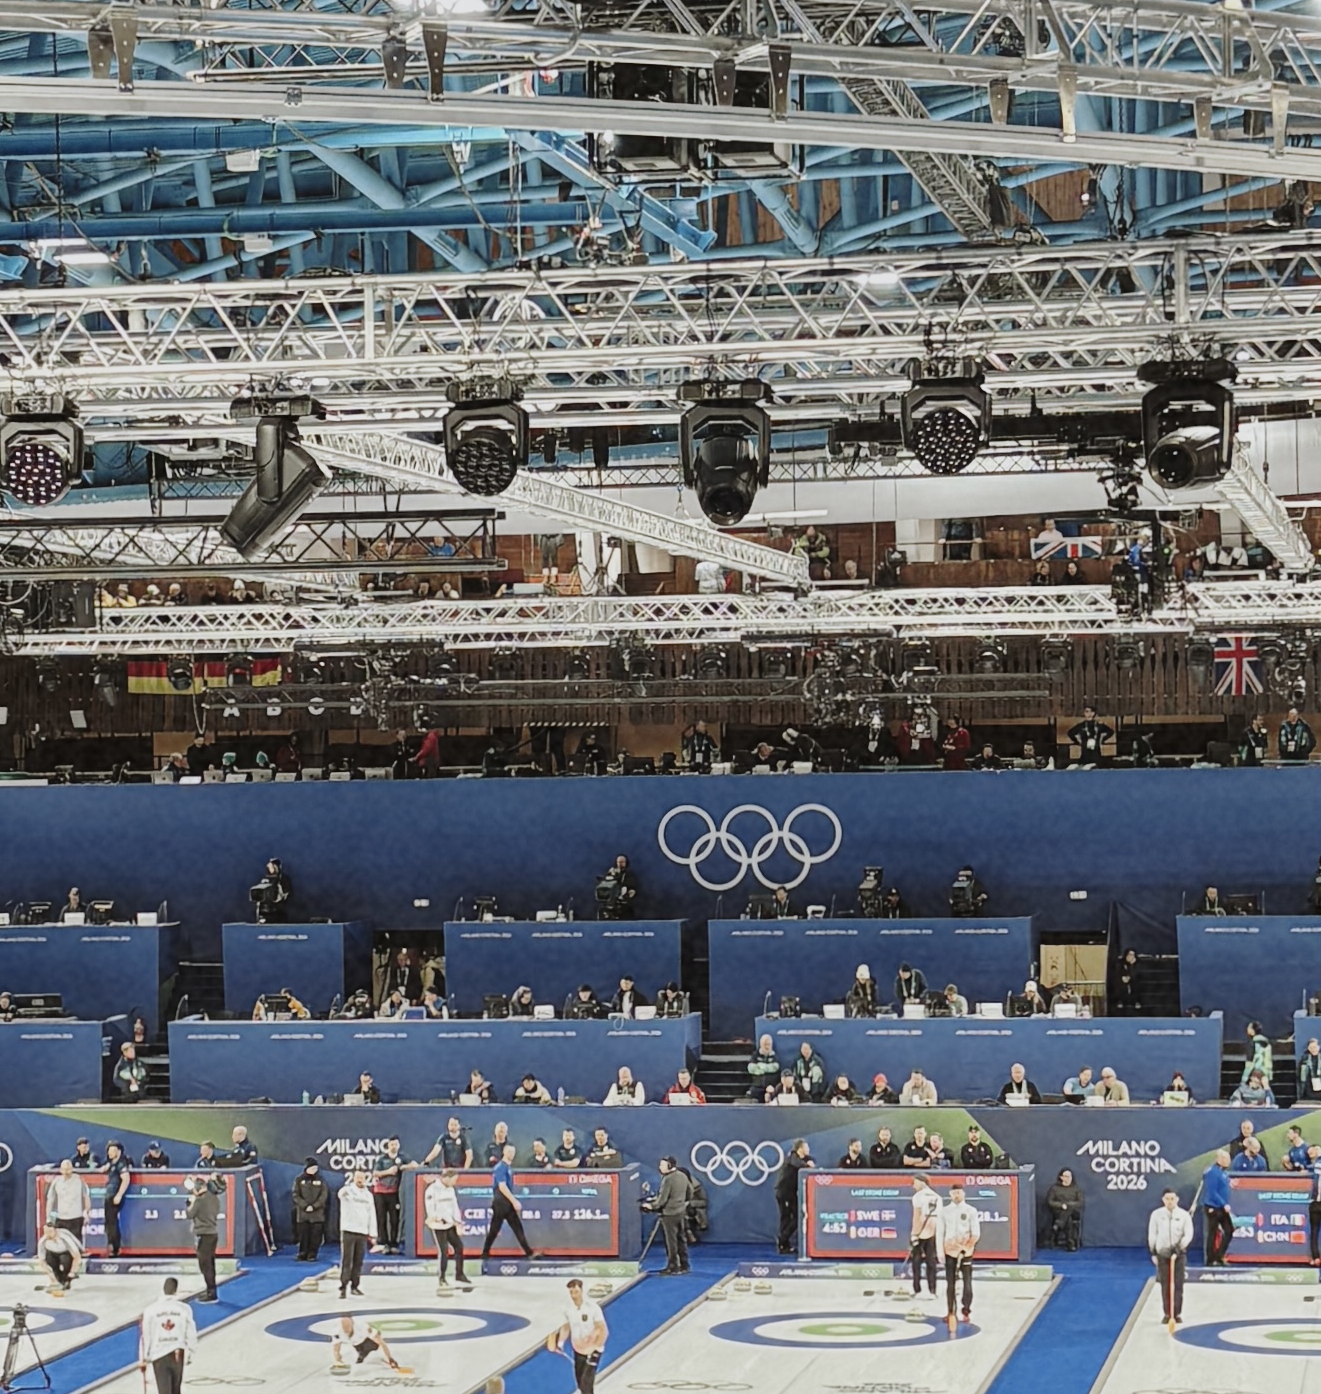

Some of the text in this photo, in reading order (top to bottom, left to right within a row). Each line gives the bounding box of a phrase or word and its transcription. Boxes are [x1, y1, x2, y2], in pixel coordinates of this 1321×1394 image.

[1076, 1139, 1161, 1157] MILANO
[1090, 1156, 1178, 1174] CORTINA
[1106, 1174, 1148, 1191] 2026
[856, 1210, 881, 1221] SWE
[462, 1224, 486, 1236] CAN
[1264, 1231, 1290, 1242] CHN
